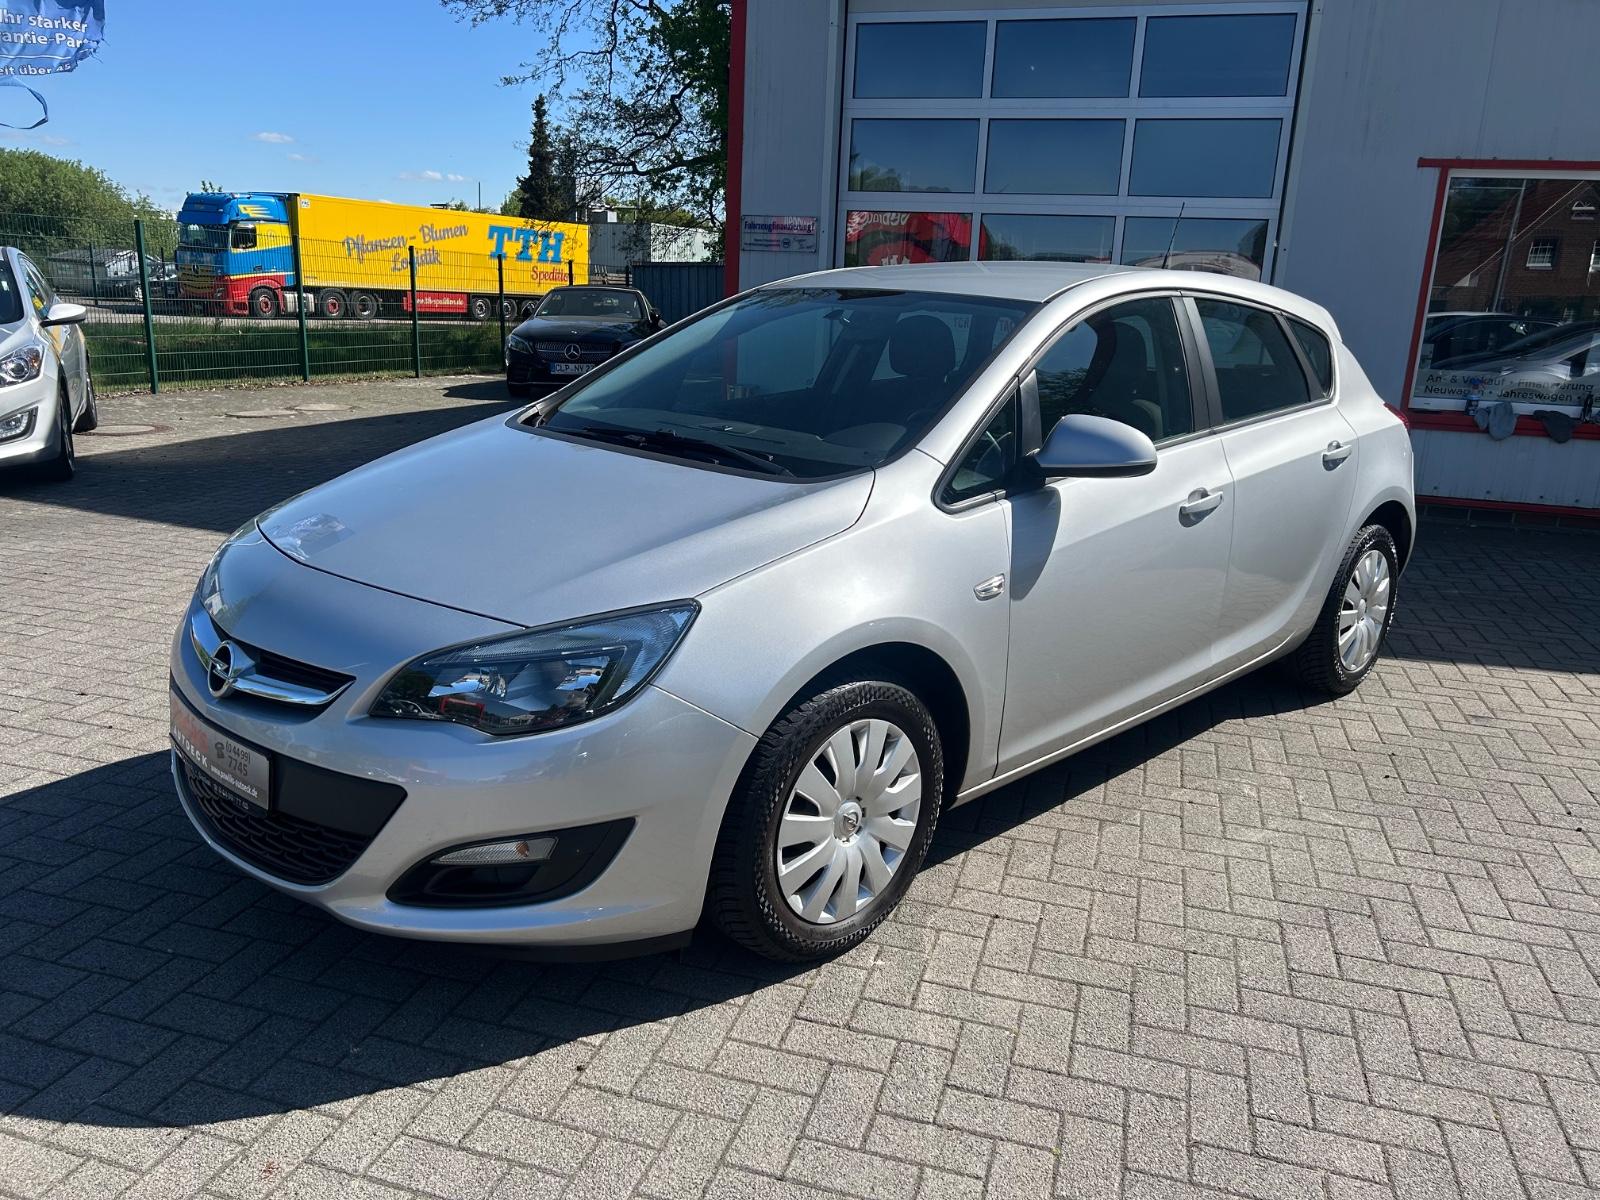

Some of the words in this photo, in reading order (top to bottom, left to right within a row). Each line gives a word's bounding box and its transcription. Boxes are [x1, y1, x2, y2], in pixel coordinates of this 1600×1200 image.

[28, 15, 88, 33] starker
[0, 31, 97, 48] antie-Par
[19, 64, 52, 75] über
[342, 234, 408, 264] Pflanzen
[419, 222, 469, 243] Blumen
[488, 224, 565, 263] TTH
[391, 246, 442, 276] Loistik
[531, 265, 576, 288] Speditio
[1462, 375, 1505, 387] Vkauf
[1424, 385, 1484, 397] Neuwagn
[1497, 389, 1572, 402] Jahreswagen
[173, 725, 208, 768] AUTOECK
